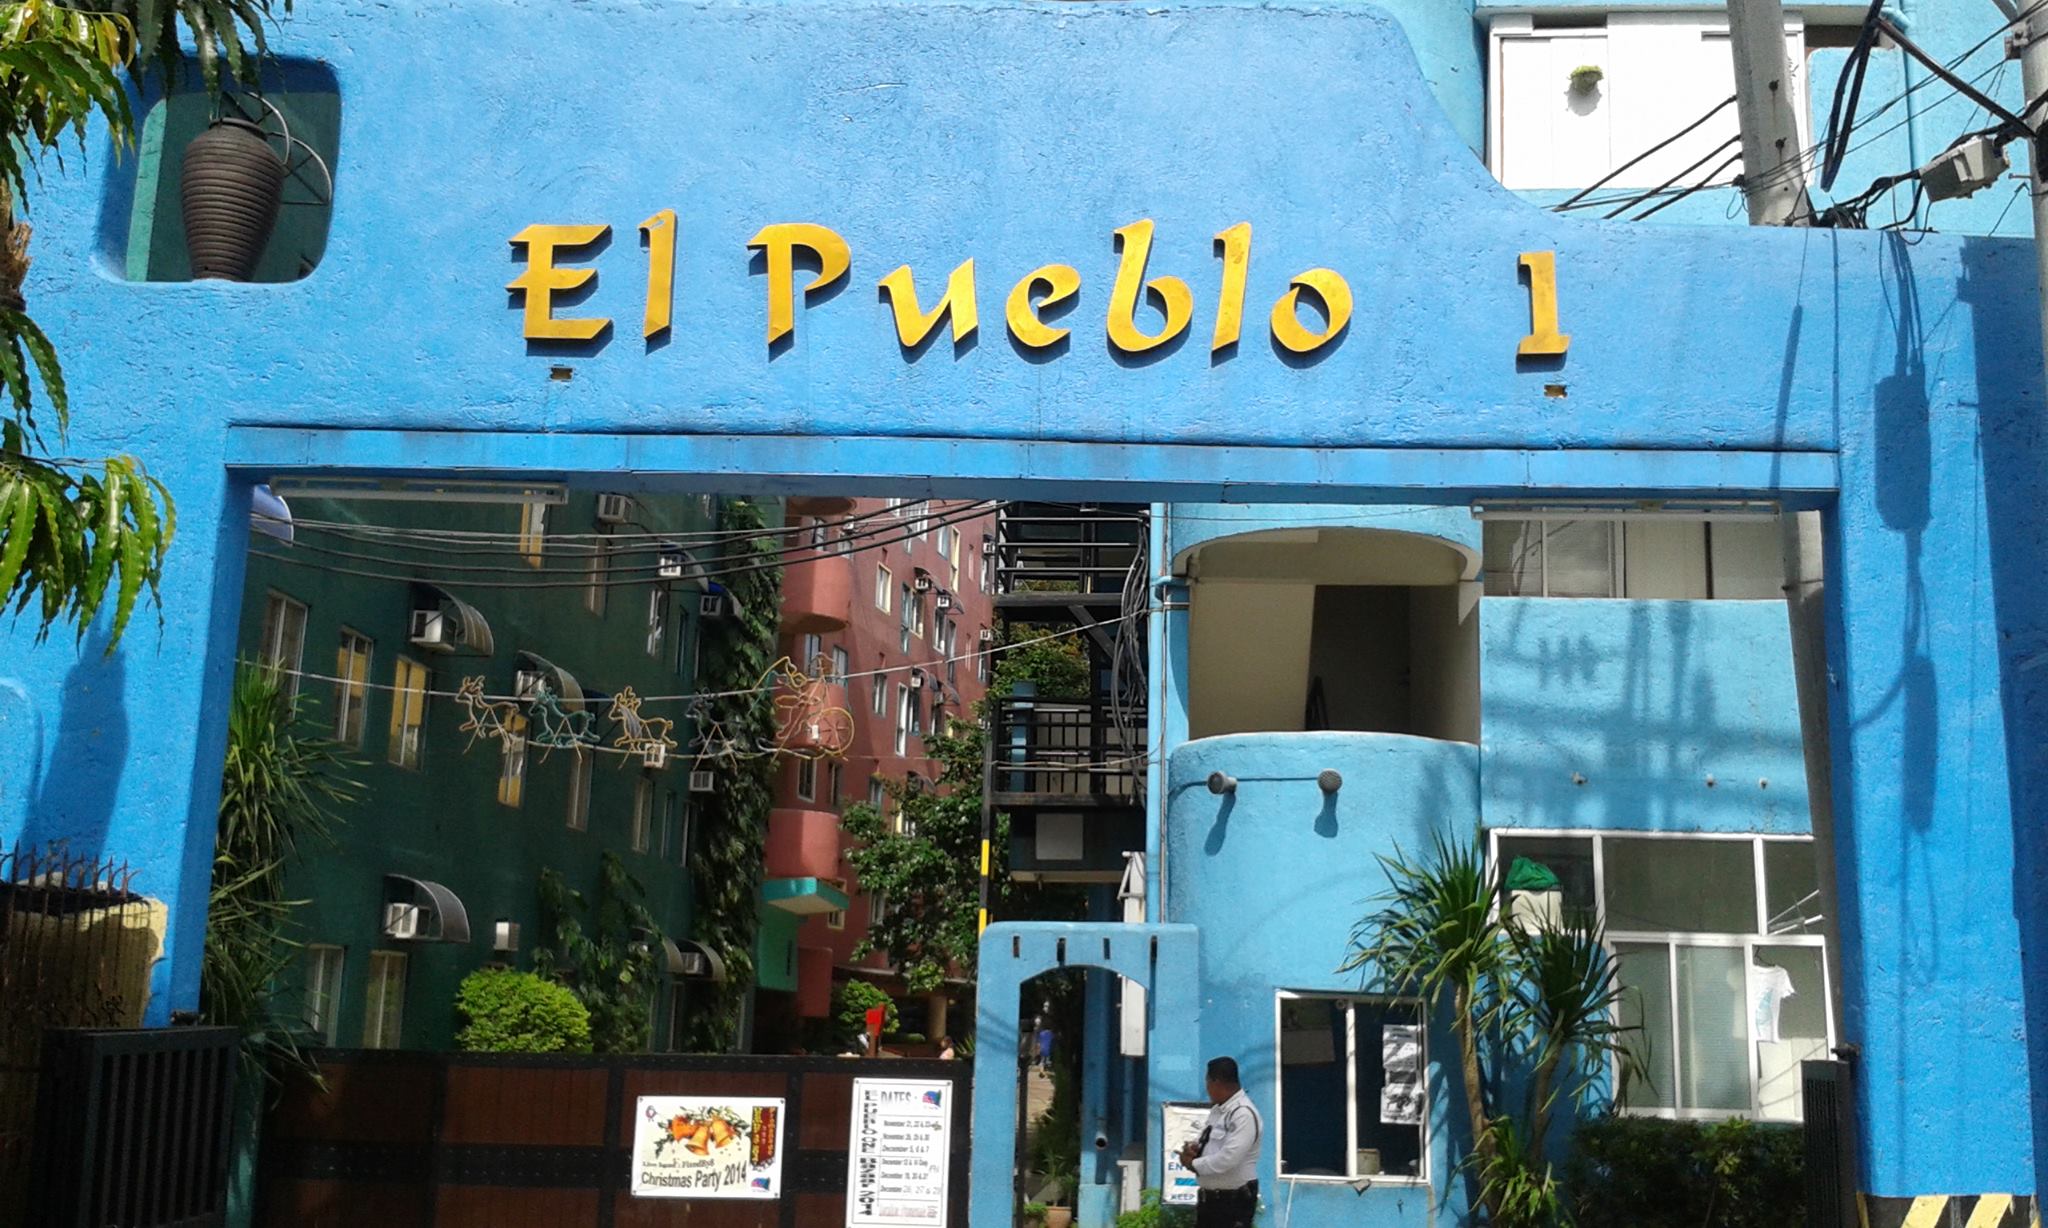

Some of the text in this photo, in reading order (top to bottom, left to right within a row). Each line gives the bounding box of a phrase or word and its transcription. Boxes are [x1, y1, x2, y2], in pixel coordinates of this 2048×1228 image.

[506, 209, 1570, 359] El Pueblo 1
[641, 1171, 692, 1188] Christmas
[694, 1169, 721, 1192] Party
[723, 1160, 747, 1186] 2014
